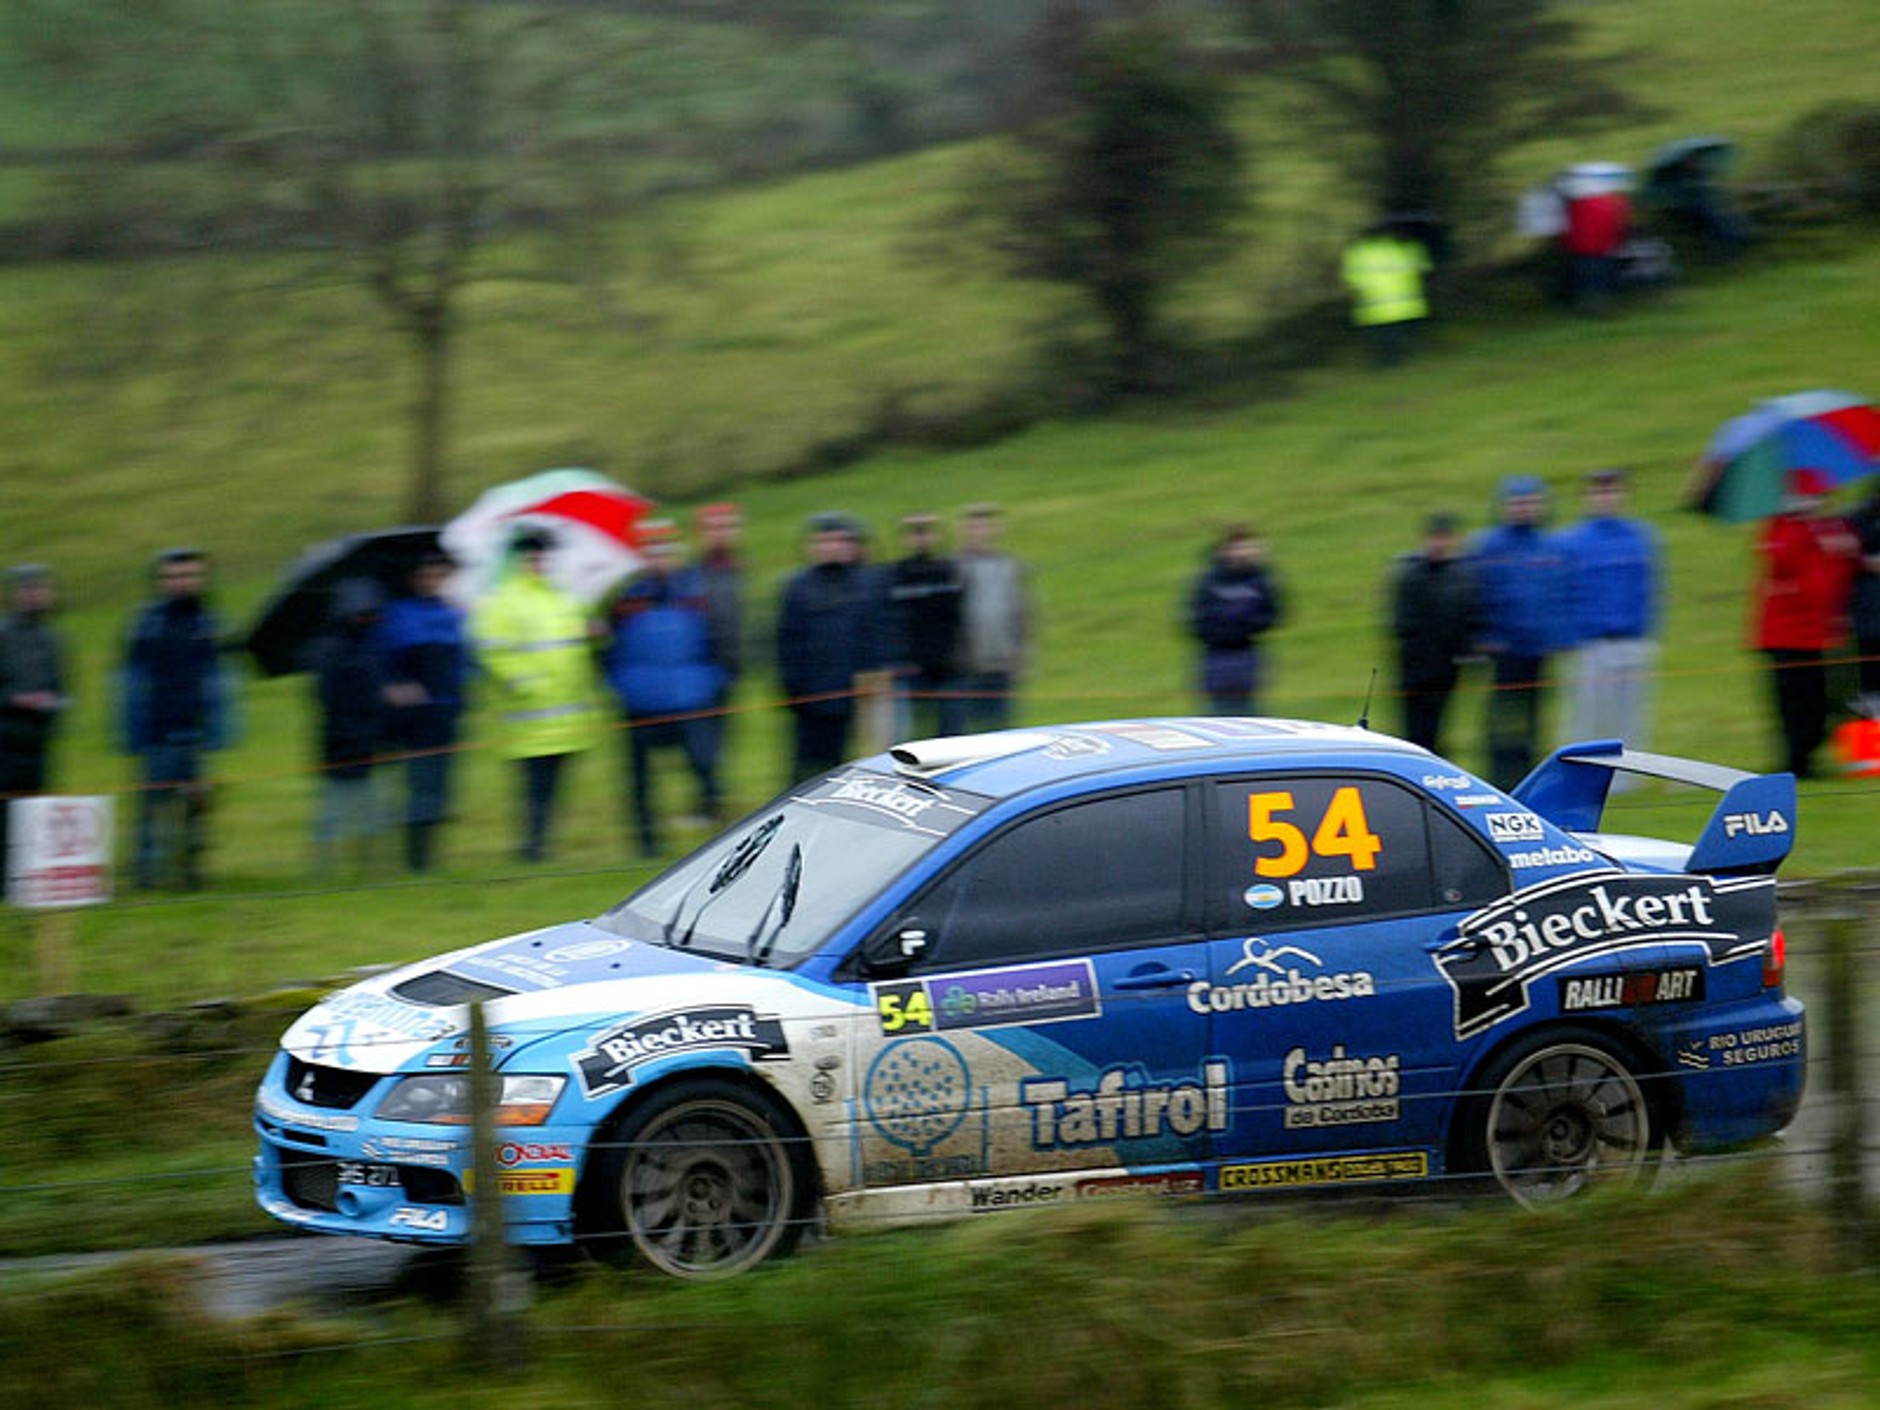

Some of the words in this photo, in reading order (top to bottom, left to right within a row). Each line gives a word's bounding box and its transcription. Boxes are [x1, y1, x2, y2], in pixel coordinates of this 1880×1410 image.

[1248, 786, 1382, 878] 54
[1490, 815, 1540, 832] NGK
[1724, 810, 1788, 838] FILA
[1508, 846, 1594, 868] metabo
[1288, 876, 1363, 906] POZZO
[1478, 885, 1714, 971] Bieckert
[1187, 969, 1375, 1014] Cordobesa
[880, 990, 932, 1031] 54
[601, 1013, 756, 1063] Bieckert
[1709, 1034, 1737, 1049] RIO
[1722, 1040, 1799, 1065] SEGUROS
[1283, 1045, 1399, 1103] Casinos
[1024, 1062, 1227, 1145] Tafirol
[1223, 1161, 1340, 1188] CROSSMANS
[970, 1181, 1064, 1206] Wander
[388, 1207, 448, 1231] FILA
